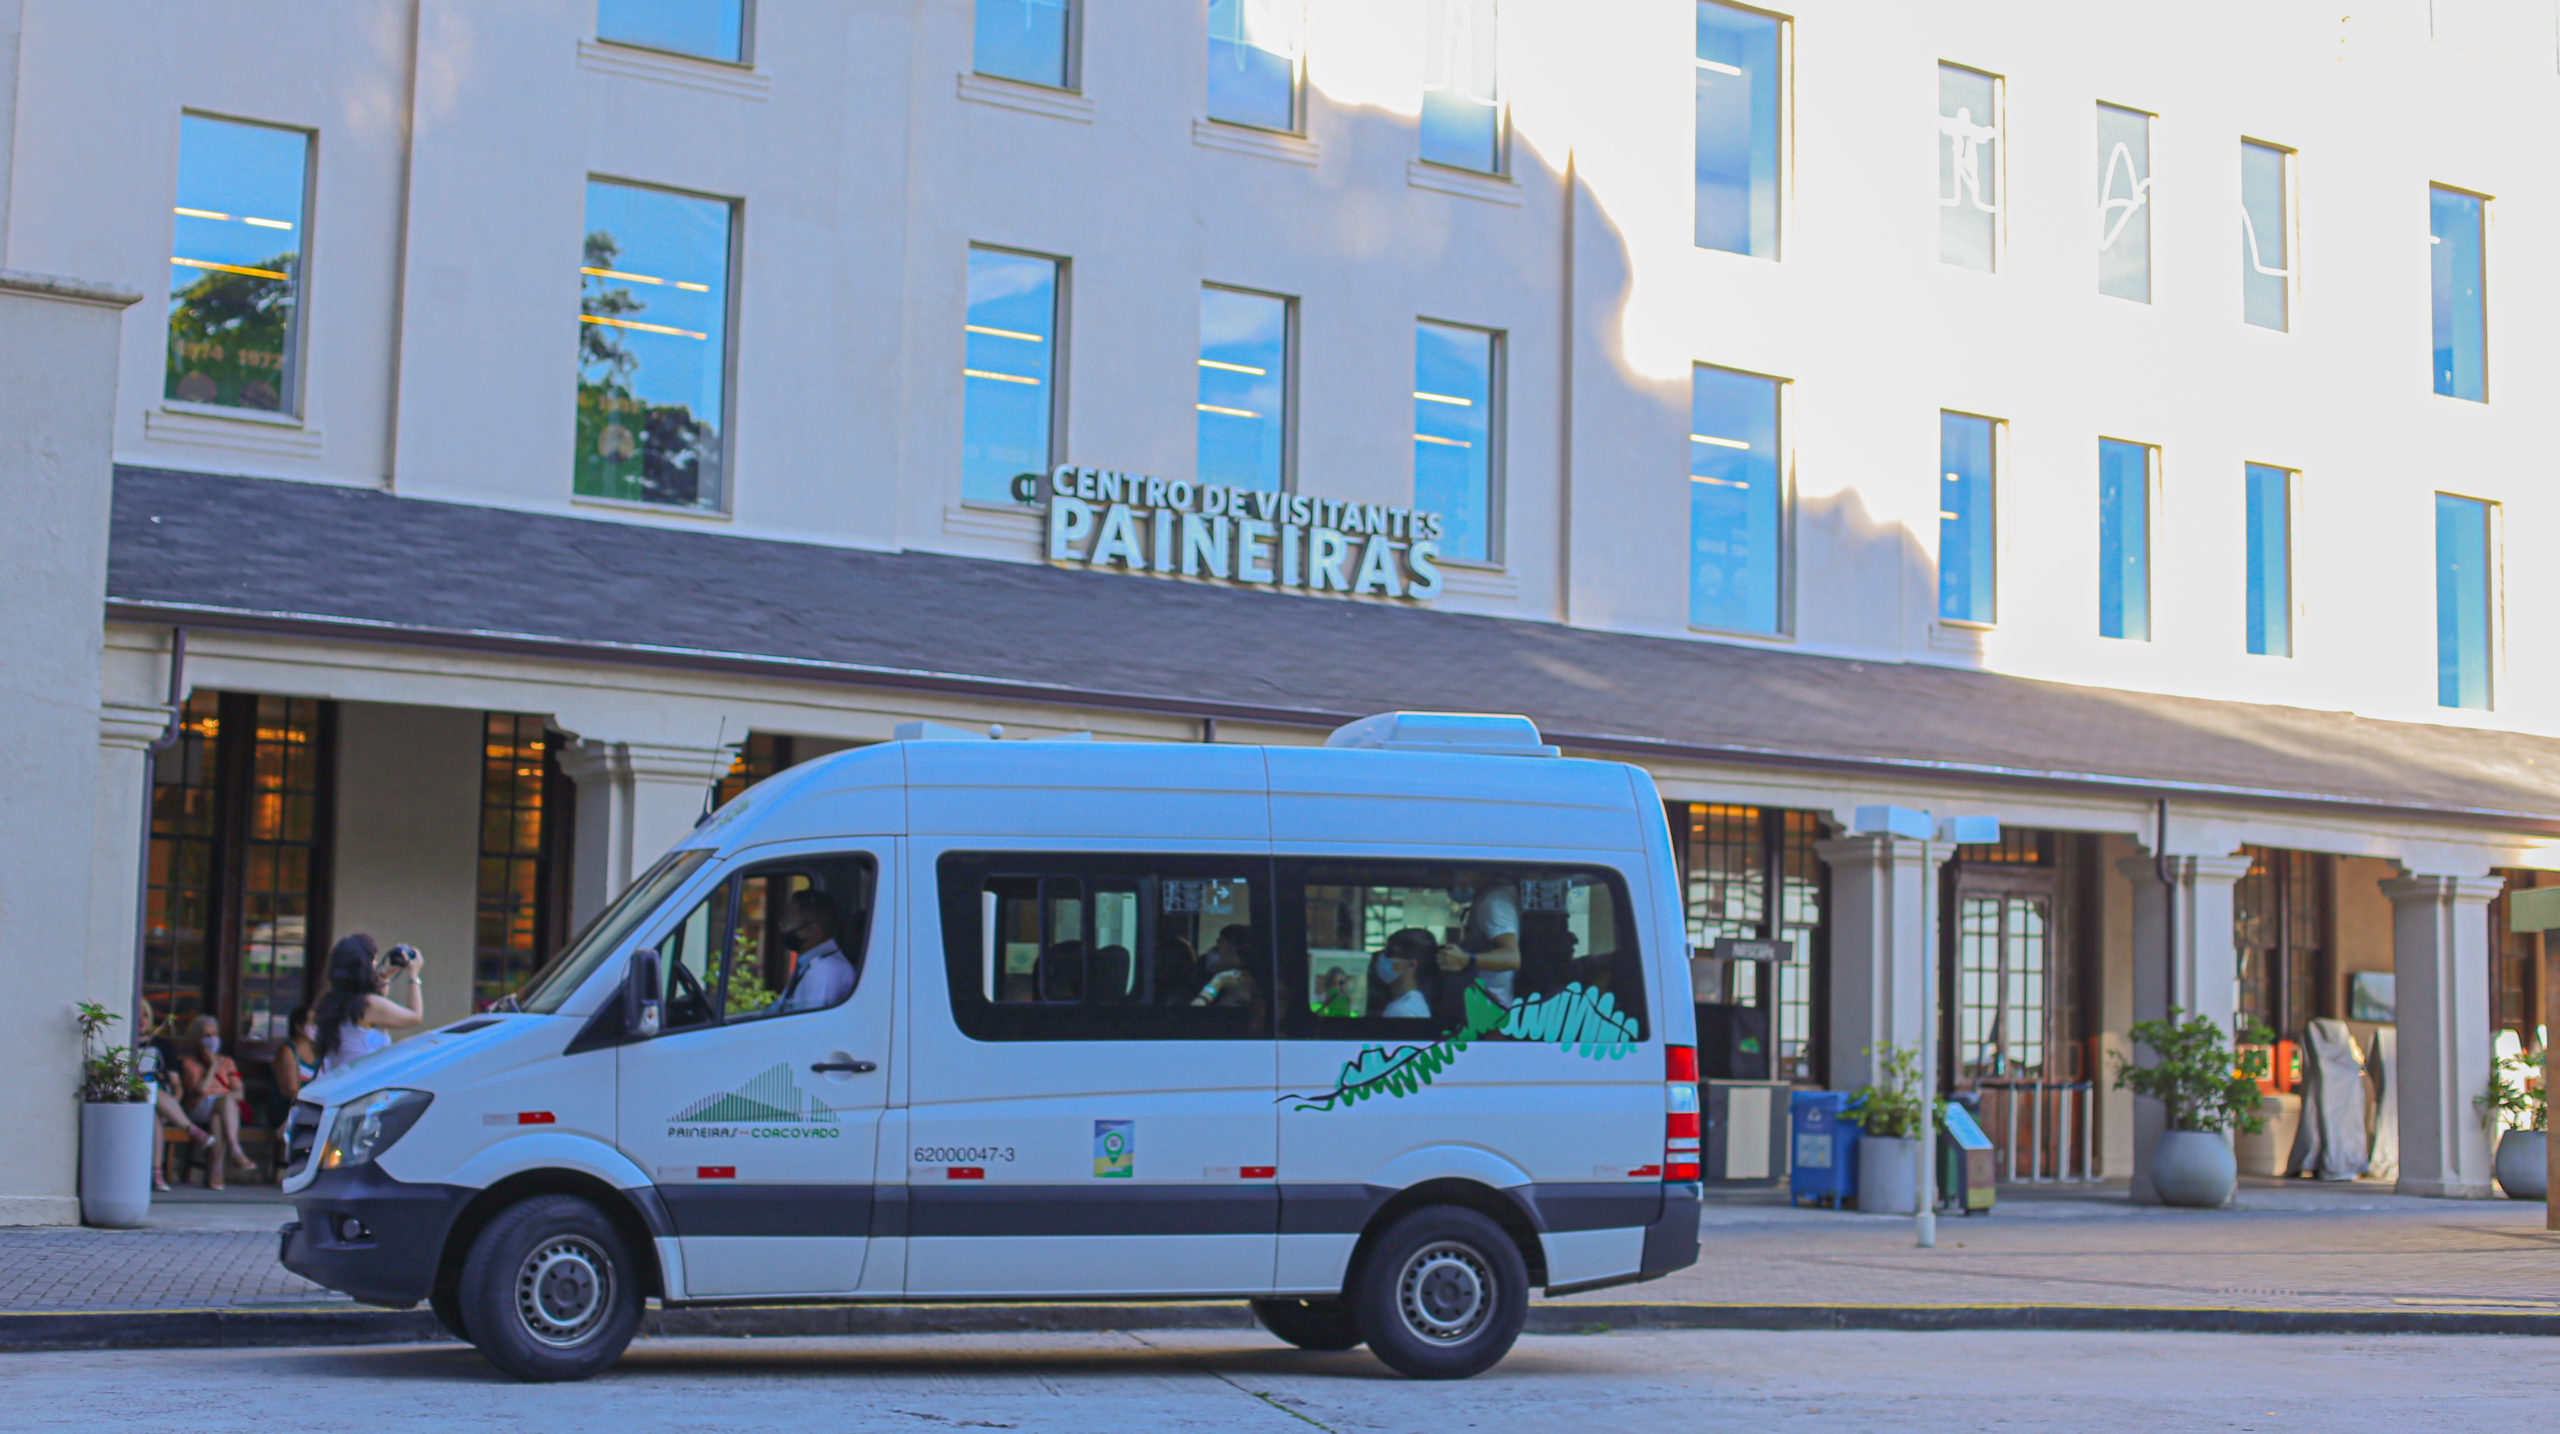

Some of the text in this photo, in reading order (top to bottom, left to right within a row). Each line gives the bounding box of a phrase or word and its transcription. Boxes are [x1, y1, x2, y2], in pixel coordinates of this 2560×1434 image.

[1052, 463, 1444, 540] CENTRO DE VISITANTES
[1049, 494, 1443, 601] PAINEIRAS
[667, 1127, 841, 1138] PAINEIRAS CORCOVADO
[914, 1147, 1016, 1162] 62000047-3
